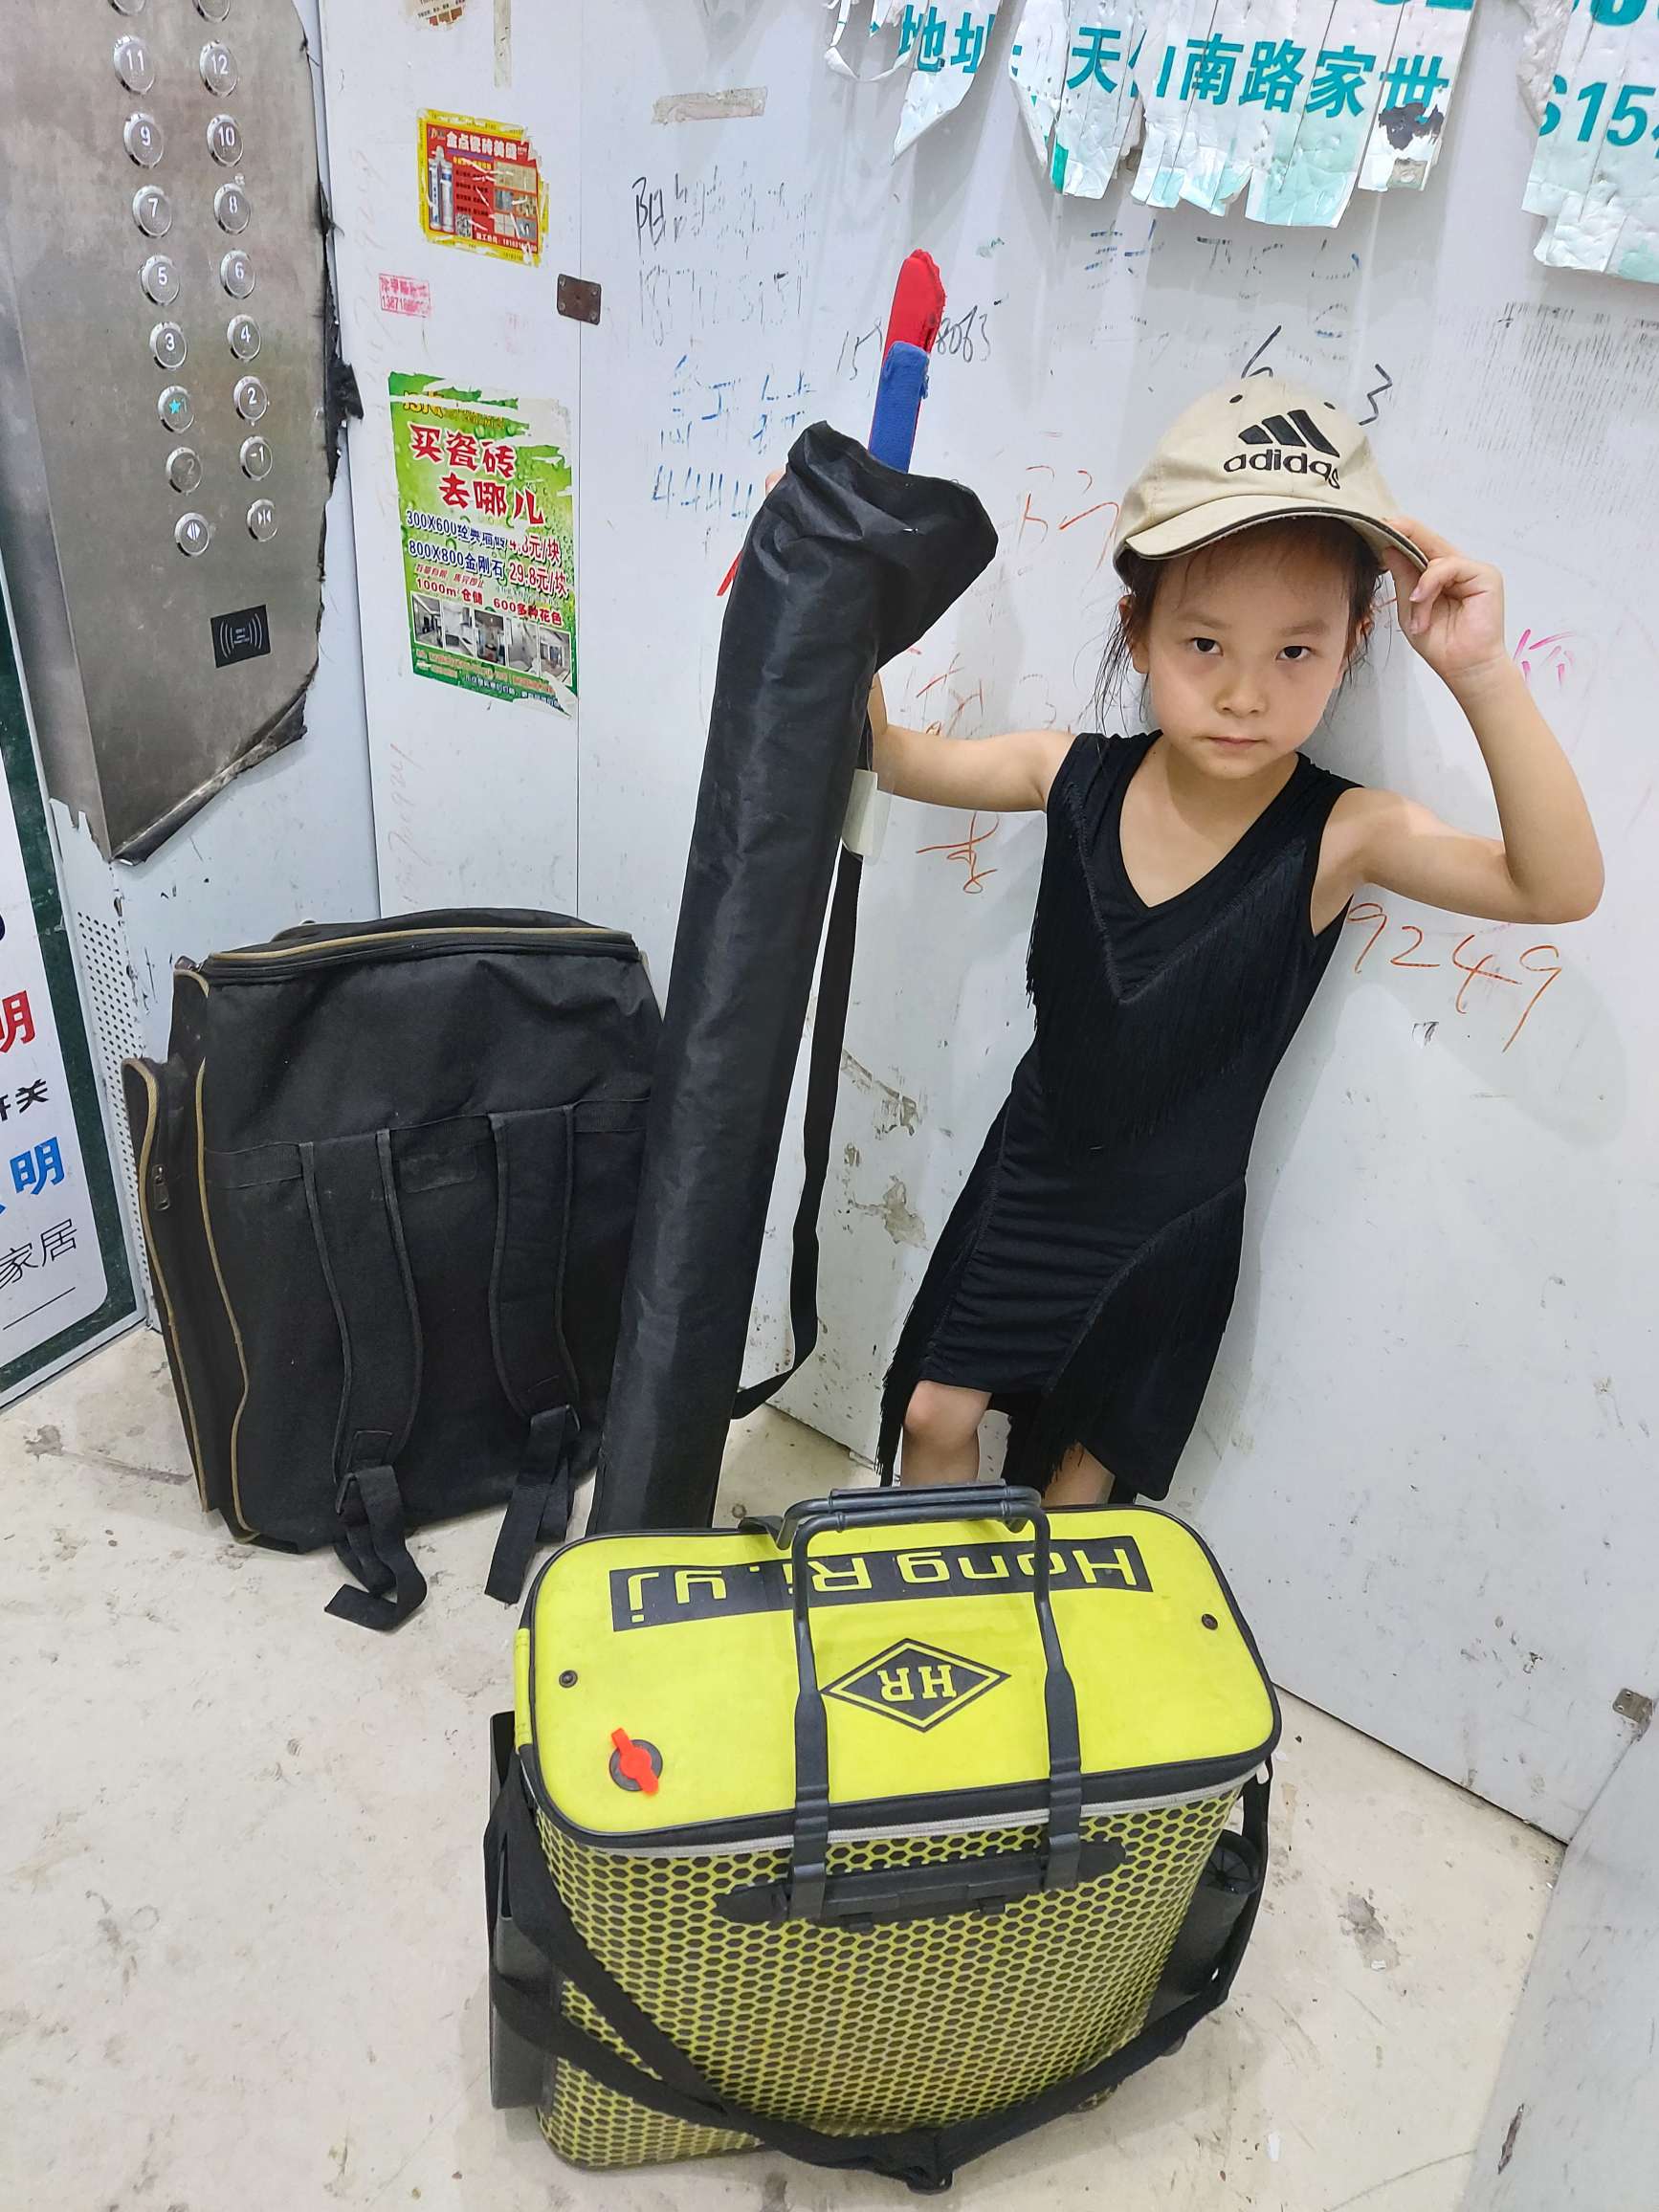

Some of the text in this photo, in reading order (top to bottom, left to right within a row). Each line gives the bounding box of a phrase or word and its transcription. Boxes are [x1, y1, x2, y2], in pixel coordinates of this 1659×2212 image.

[126, 49, 144, 72] 11
[210, 54, 229, 75] 12
[140, 125, 151, 146] 9
[218, 125, 235, 146] 10
[147, 197, 159, 218] 7
[229, 195, 238, 214] 8
[157, 266, 168, 286] 5
[234, 261, 245, 280] 6
[165, 332, 175, 352] 3
[240, 324, 251, 343] 4
[247, 387, 256, 405] 2
[409, 423, 517, 479] 买瓷砖
[1223, 449, 1341, 489] adidas
[438, 473, 545, 525] 去哪儿
[896, 1547, 1138, 1587] Hong
[876, 1665, 958, 1703] HR
